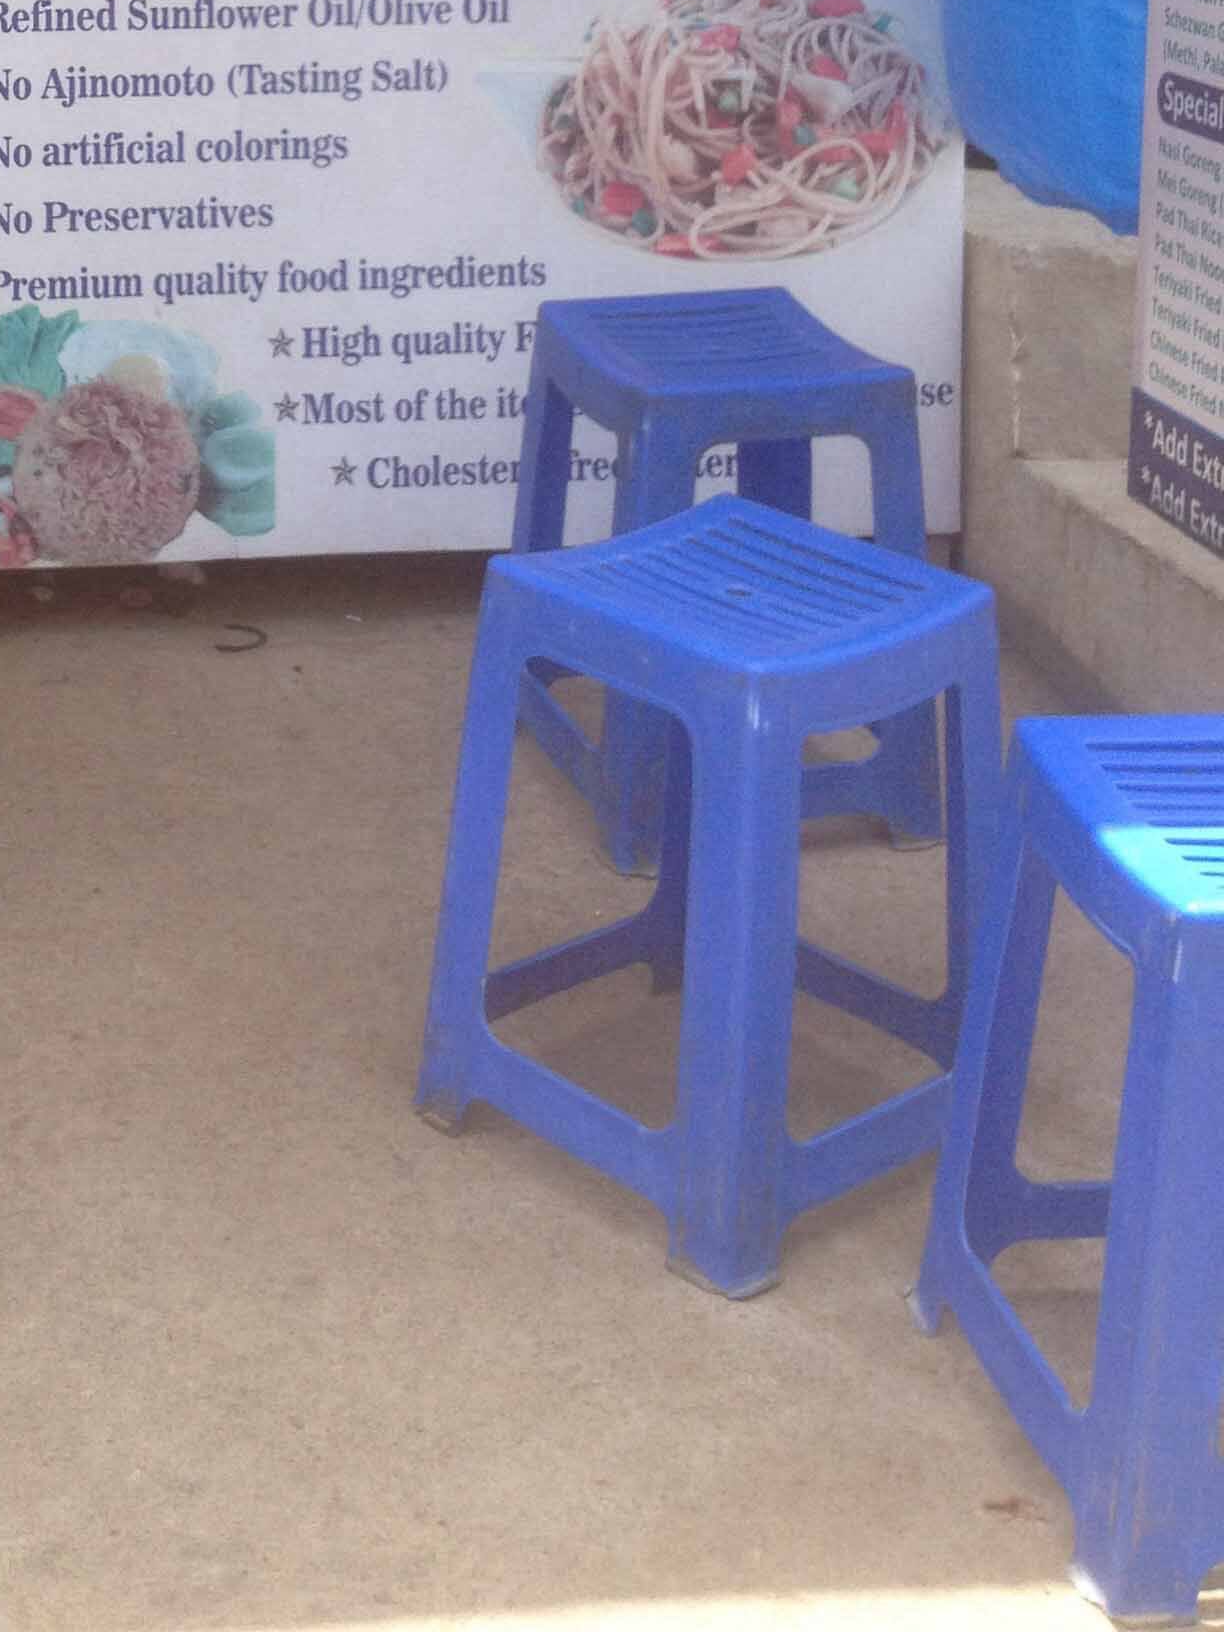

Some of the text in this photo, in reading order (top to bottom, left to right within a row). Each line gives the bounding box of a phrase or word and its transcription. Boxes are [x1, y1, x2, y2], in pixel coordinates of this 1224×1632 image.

[1164, 6, 1216, 41] Schezwan
[41, 65, 216, 107] Ajinomoto
[226, 61, 363, 101] (Tasting
[370, 58, 449, 93] Salt)
[42, 131, 186, 167] artificial
[196, 129, 350, 169] colorings
[43, 197, 274, 234] Preservatives
[1156, 201, 1175, 225] Pad
[1155, 233, 1173, 258] Pad
[153, 263, 270, 305] quality
[277, 258, 350, 293] food
[358, 255, 547, 299] ingredients
[1195, 285, 1222, 316] Fried
[301, 325, 382, 363] High
[392, 323, 507, 364] quality
[1193, 317, 1221, 349] Fried
[1191, 351, 1218, 383] Fried
[302, 390, 384, 425] Most
[394, 387, 431, 423] of
[435, 385, 488, 421] the
[1190, 384, 1217, 416] Fried
[366, 451, 521, 489] Cholester
